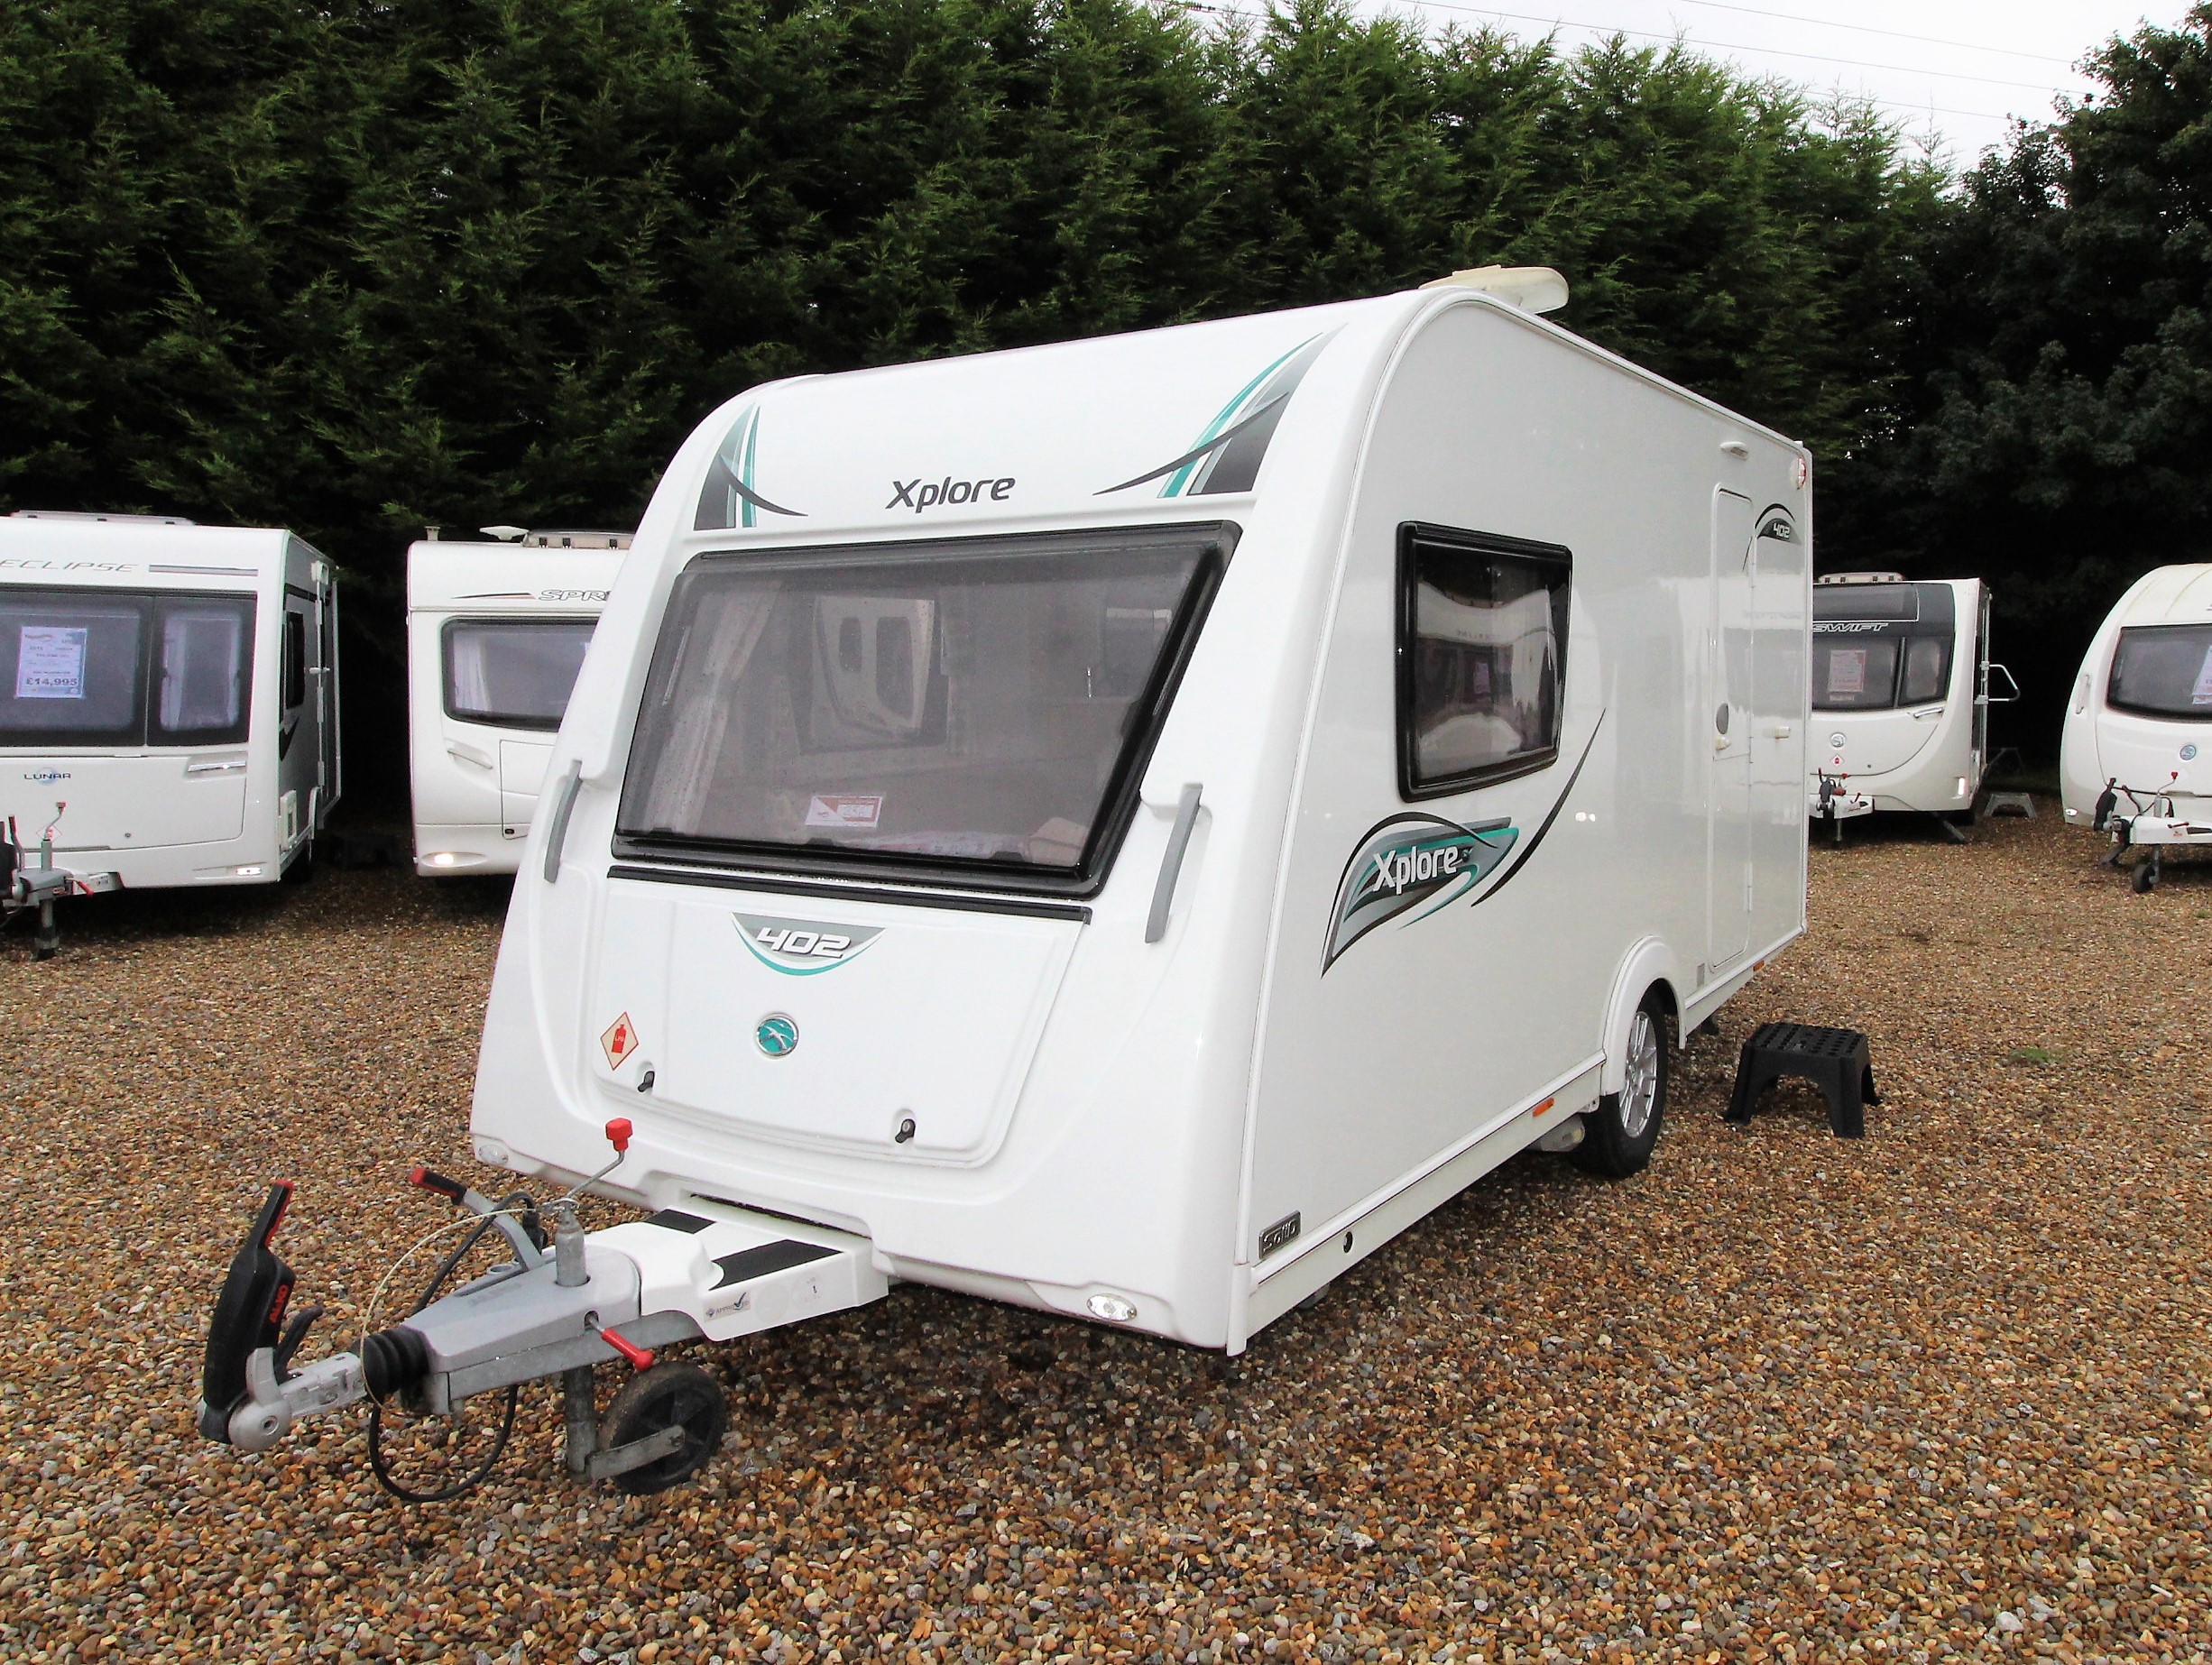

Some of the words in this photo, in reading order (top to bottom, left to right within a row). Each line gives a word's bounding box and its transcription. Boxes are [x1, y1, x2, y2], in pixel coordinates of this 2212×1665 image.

[884, 476, 1016, 514] Xplore
[1773, 522, 1791, 538] 402
[0, 558, 139, 573] ECLIPSE
[1812, 622, 1889, 633] SWIFT
[25, 676, 78, 686] £14,995
[23, 772, 72, 780] LUNAR
[1371, 845, 1460, 896] Xplore
[756, 926, 853, 959] 402
